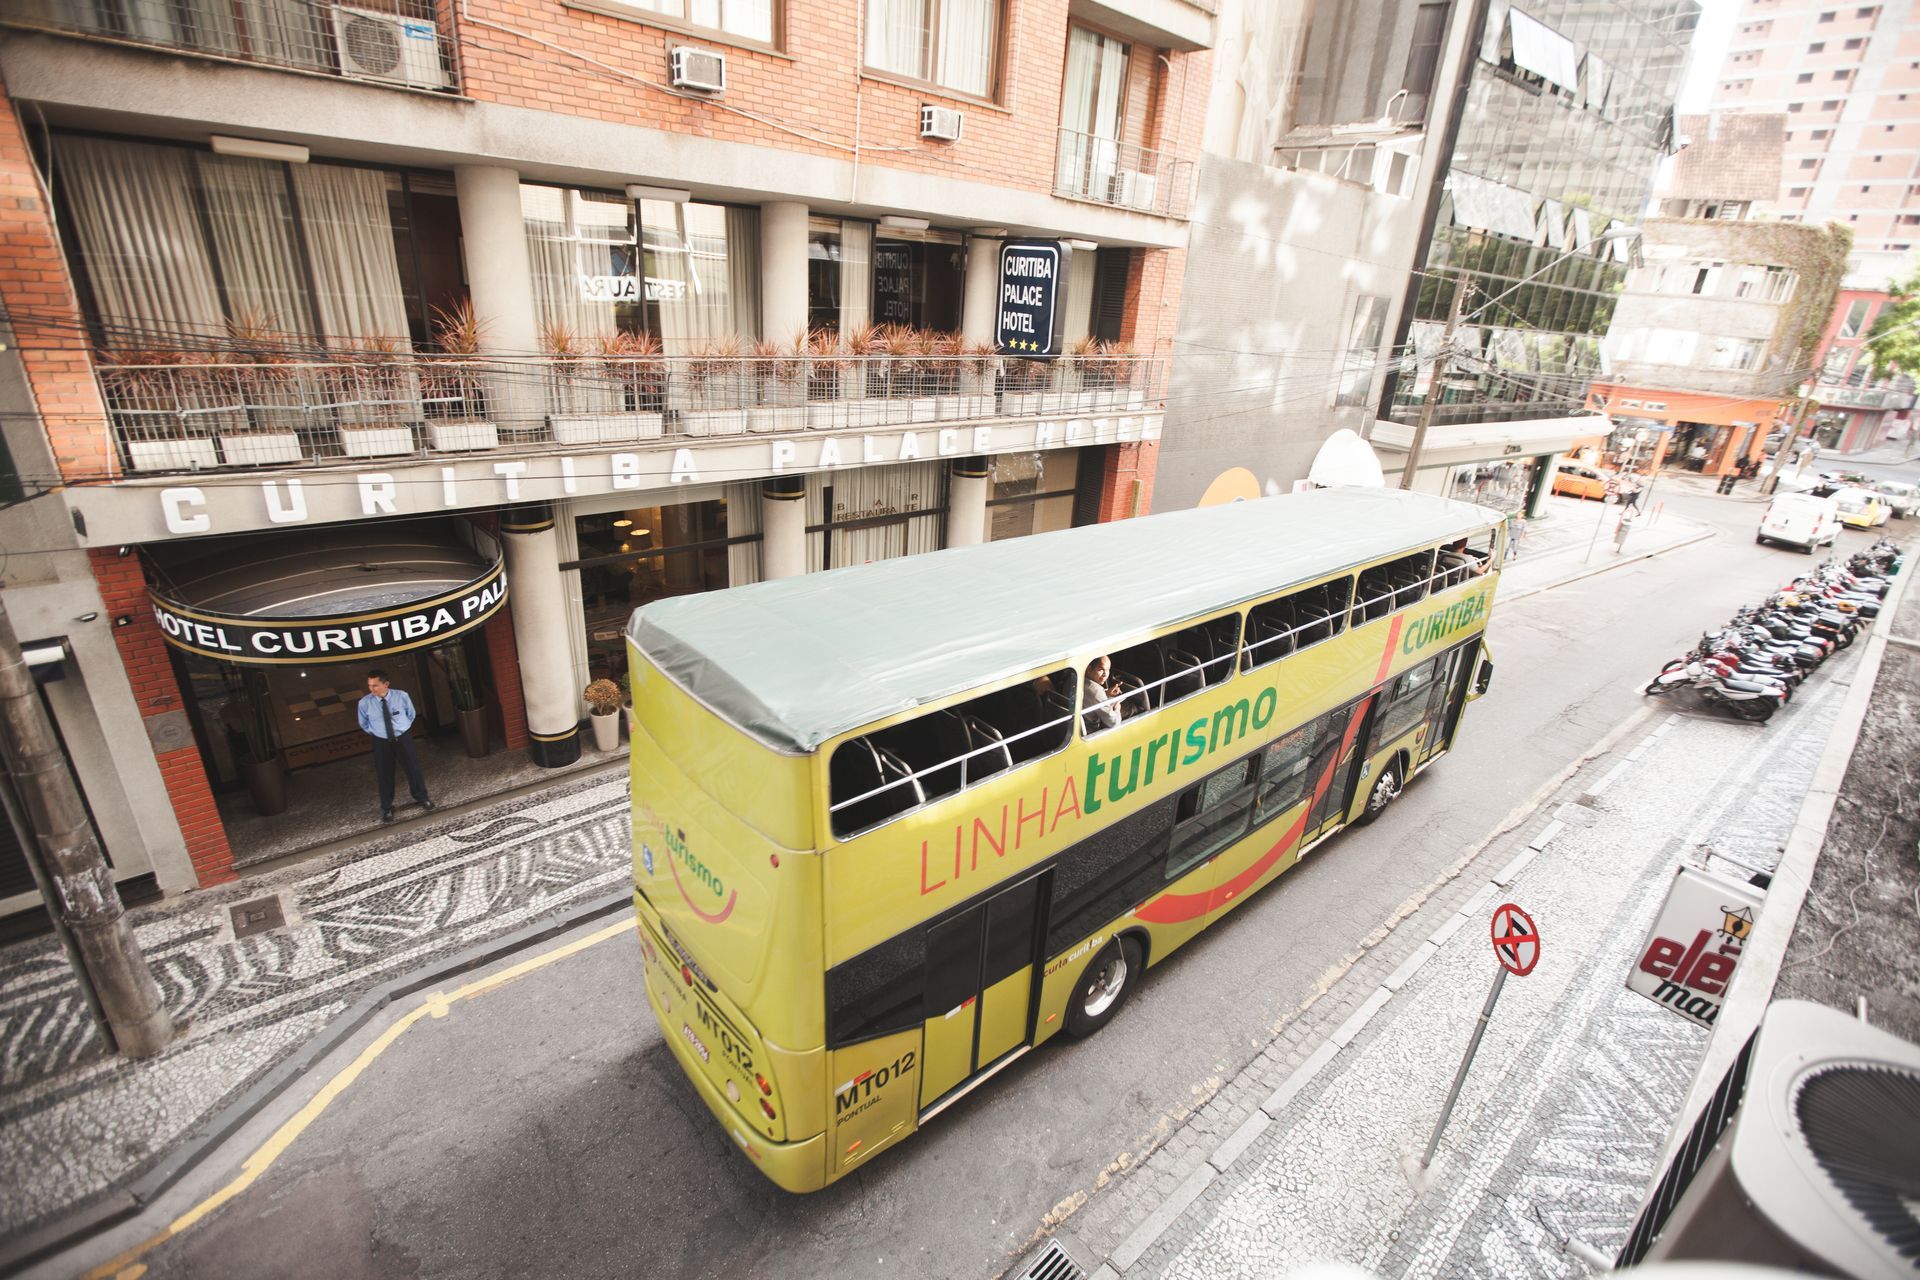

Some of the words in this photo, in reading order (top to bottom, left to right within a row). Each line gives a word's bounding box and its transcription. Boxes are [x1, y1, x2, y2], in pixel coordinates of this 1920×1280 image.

[1005, 255, 1052, 279] CURITIBA
[1004, 283, 1043, 307] PALACE
[1003, 310, 1035, 334] HOTEL
[160, 449, 699, 534] CURITIBA
[772, 426, 992, 474] PALACE
[1034, 416, 1155, 447] HOTEL
[154, 606, 242, 651] HOTEL
[251, 607, 456, 653] CURITIBA
[1403, 591, 1485, 655] CURITIBA
[836, 1051, 916, 1116] MT012
[836, 1095, 882, 1127] PONTUAL
